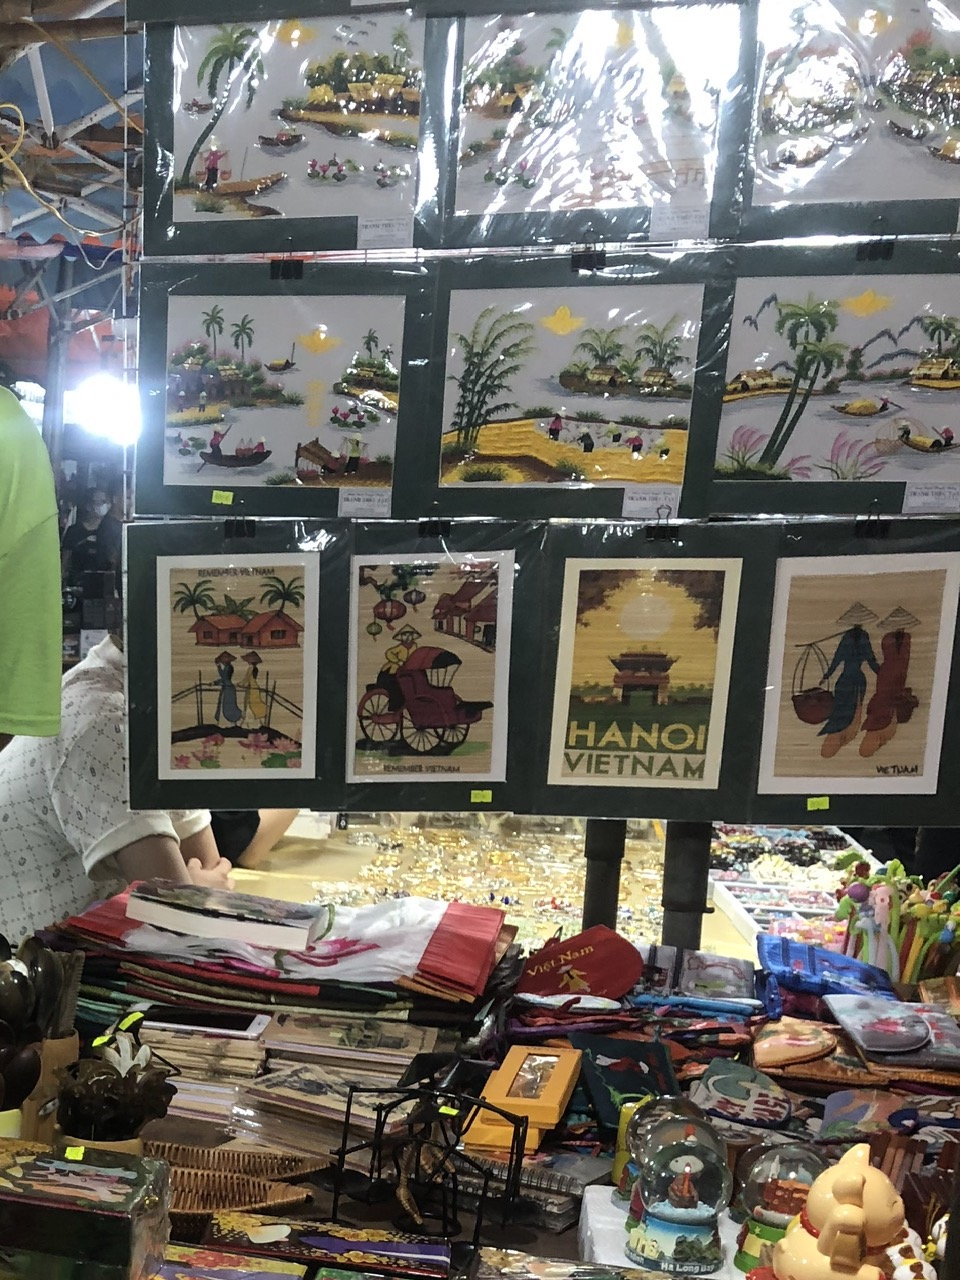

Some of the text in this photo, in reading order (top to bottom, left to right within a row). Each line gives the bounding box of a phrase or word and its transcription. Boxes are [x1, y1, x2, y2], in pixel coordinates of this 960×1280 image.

[197, 567, 275, 577] REMEMBER VIETNAM
[568, 721, 706, 750] HANOI
[383, 764, 461, 774] REMEMBER VIETNAM
[564, 752, 706, 779] VIETNAM
[558, 945, 594, 964] Nam
[660, 1262, 715, 1273] Ha Long Bay
